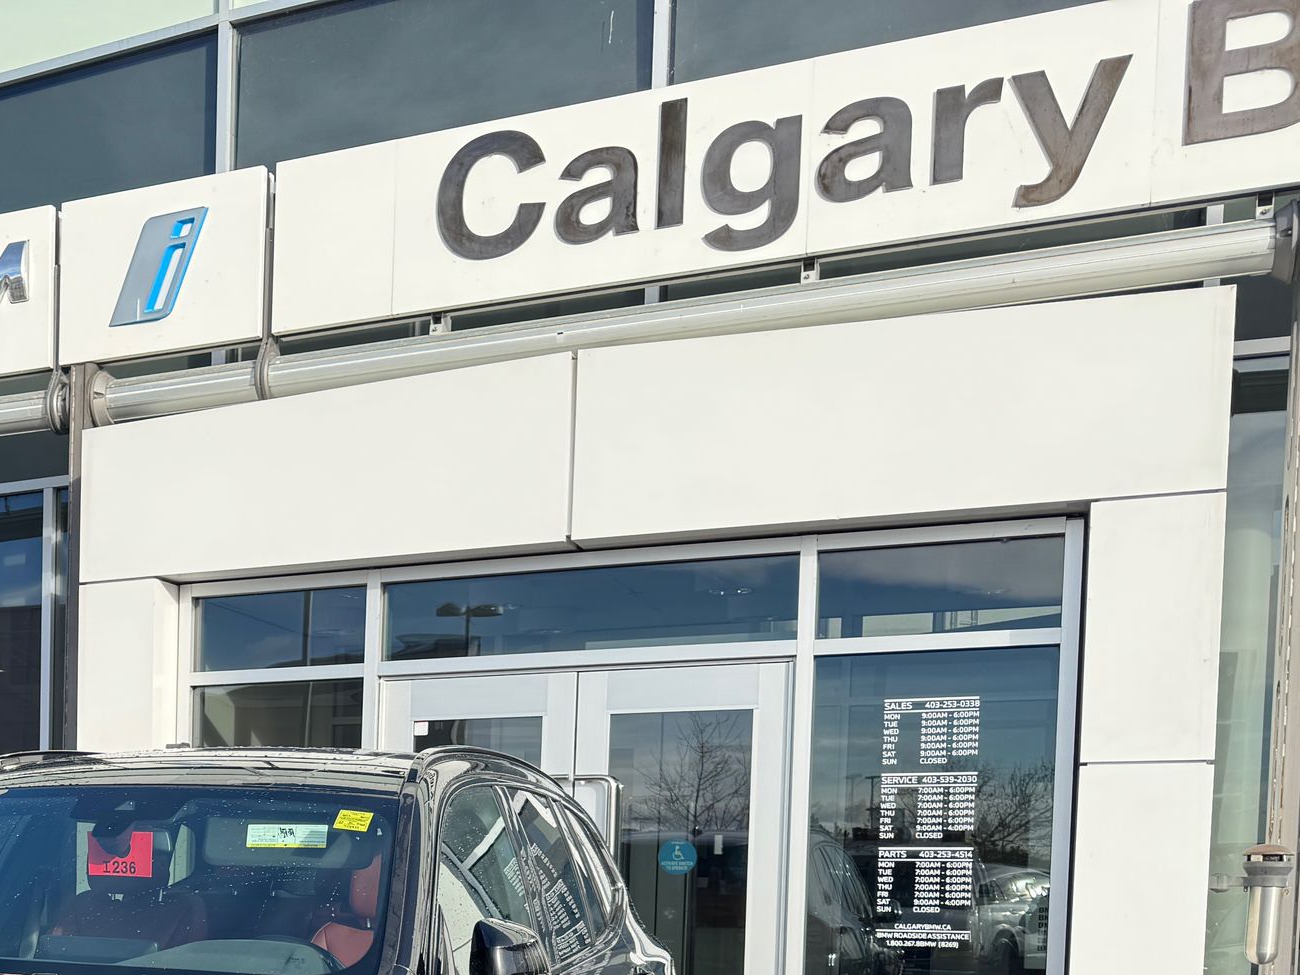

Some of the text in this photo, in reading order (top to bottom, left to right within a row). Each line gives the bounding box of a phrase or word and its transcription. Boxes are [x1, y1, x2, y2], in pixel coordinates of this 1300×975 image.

[437, 54, 1133, 261] Calgary
[884, 700, 980, 710] SALES 403-253-0338
